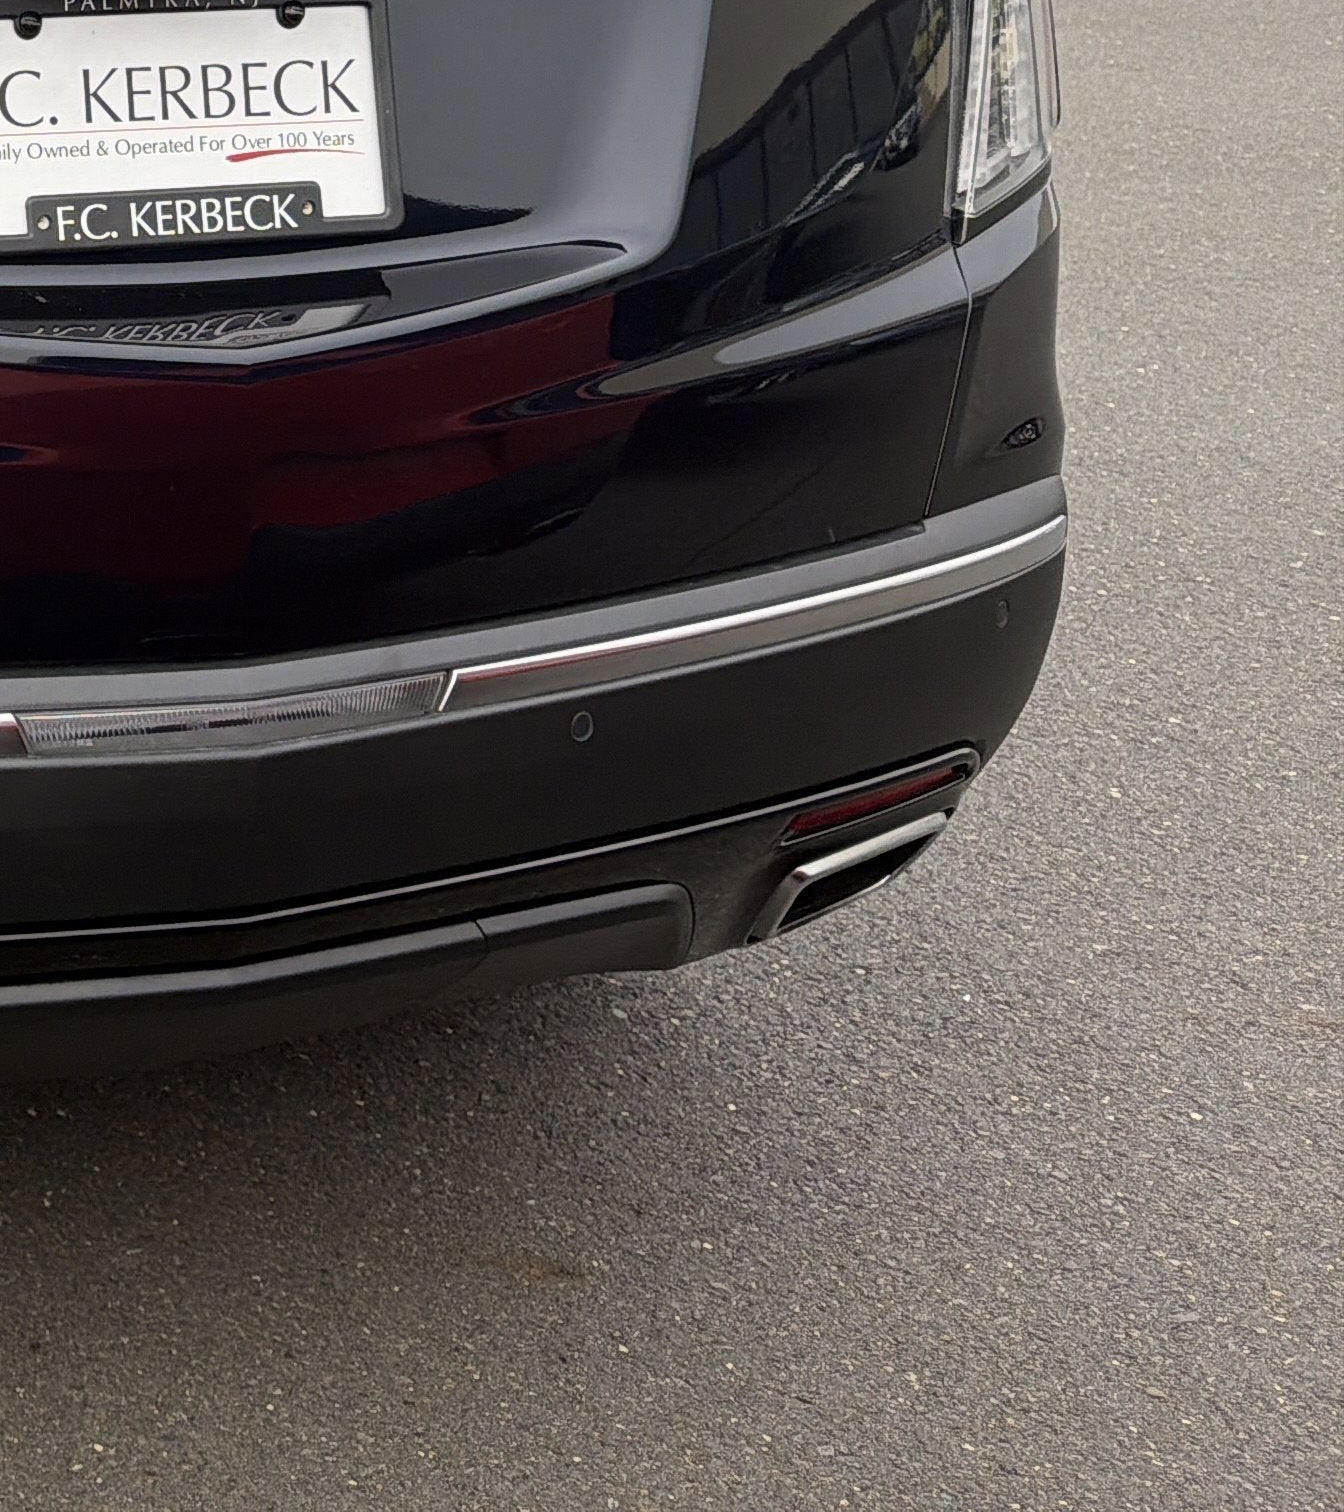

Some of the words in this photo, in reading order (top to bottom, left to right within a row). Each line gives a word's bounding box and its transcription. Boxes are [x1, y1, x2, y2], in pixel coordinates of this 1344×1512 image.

[82, 59, 360, 124] KERBECK
[26, 139, 90, 160] Owned
[96, 140, 109, 157] &
[115, 135, 194, 159] Operated
[199, 135, 226, 152] For
[231, 133, 272, 151] Over
[277, 131, 308, 148] 100
[312, 130, 355, 147] Years
[56, 203, 118, 241] F.C.
[129, 193, 299, 238] KERBECK
